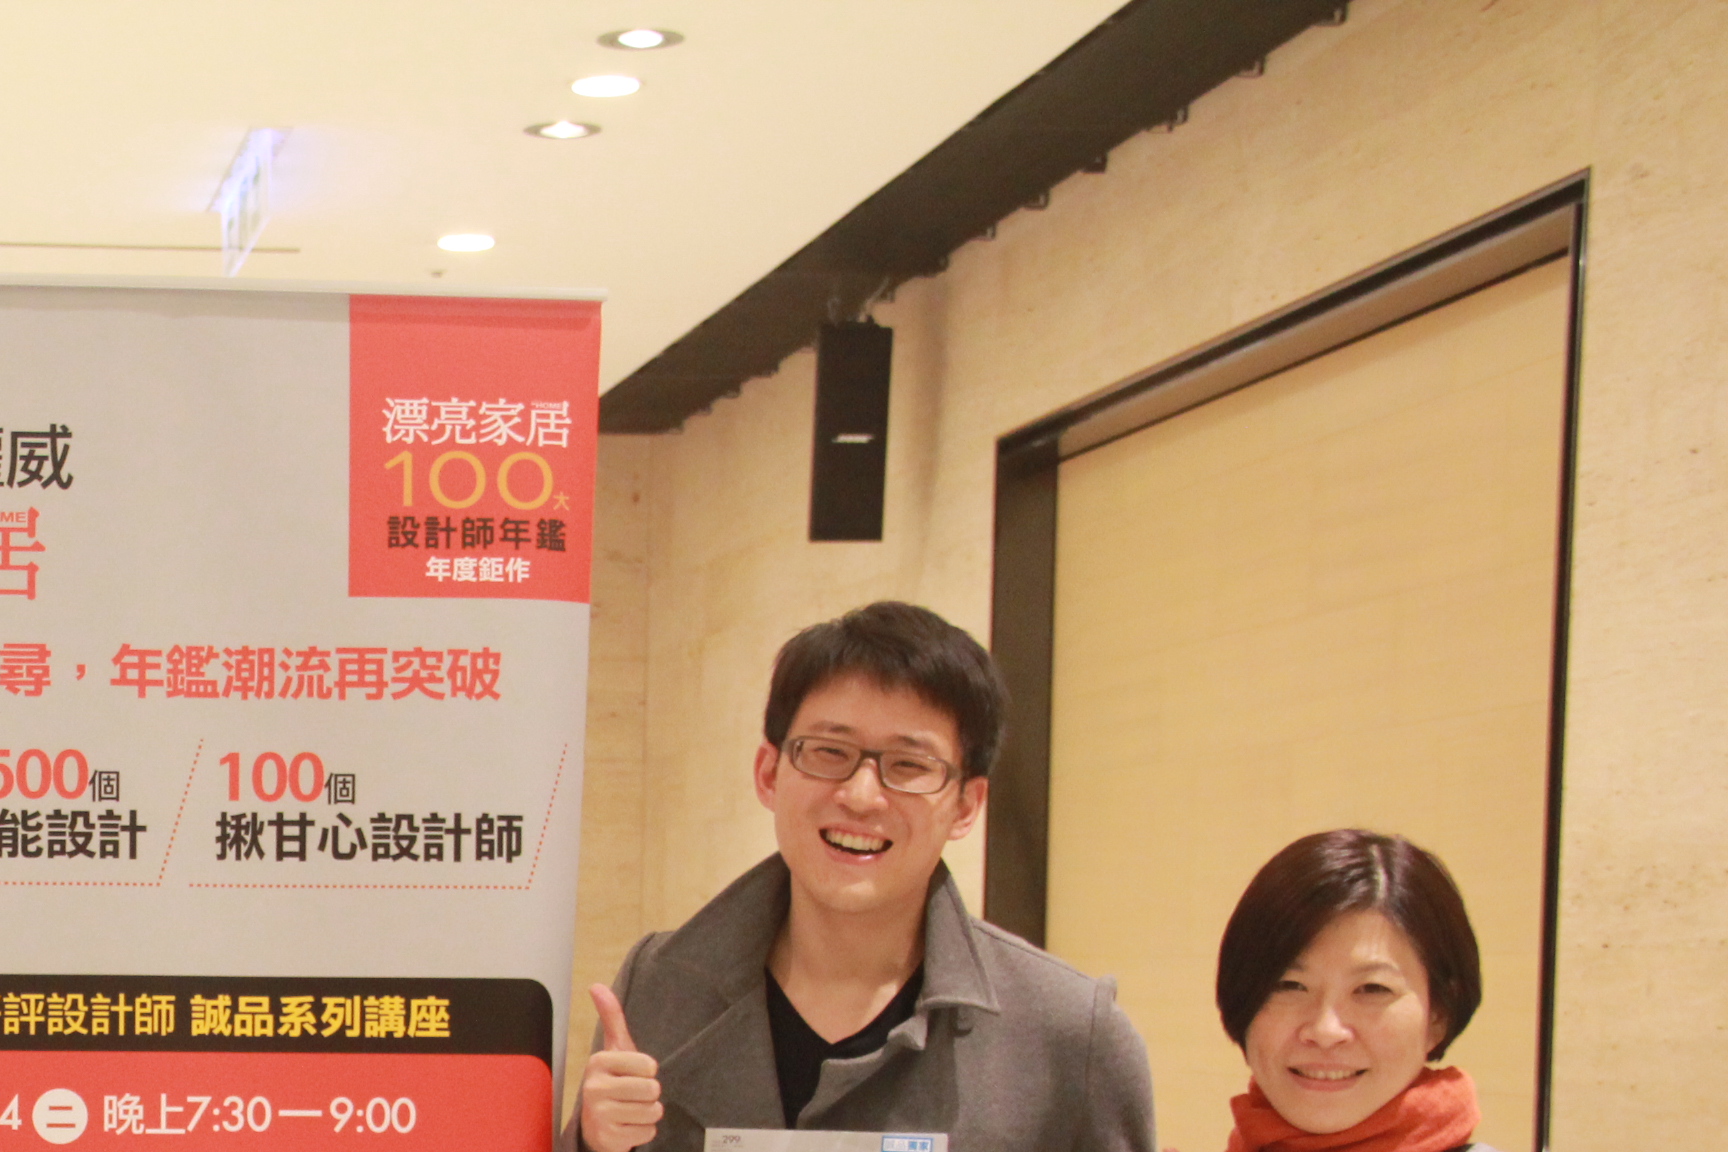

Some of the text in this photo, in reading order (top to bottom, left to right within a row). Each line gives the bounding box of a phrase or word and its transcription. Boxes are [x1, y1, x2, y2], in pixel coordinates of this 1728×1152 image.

[382, 397, 572, 448] 漂亮家居
[387, 516, 567, 552] 設計師年鑑
[425, 556, 532, 583] 年度鉅作
[217, 750, 357, 806] 100個
[215, 809, 522, 864] 揪甘心設計師
[190, 996, 451, 1040] 誠品系列講座
